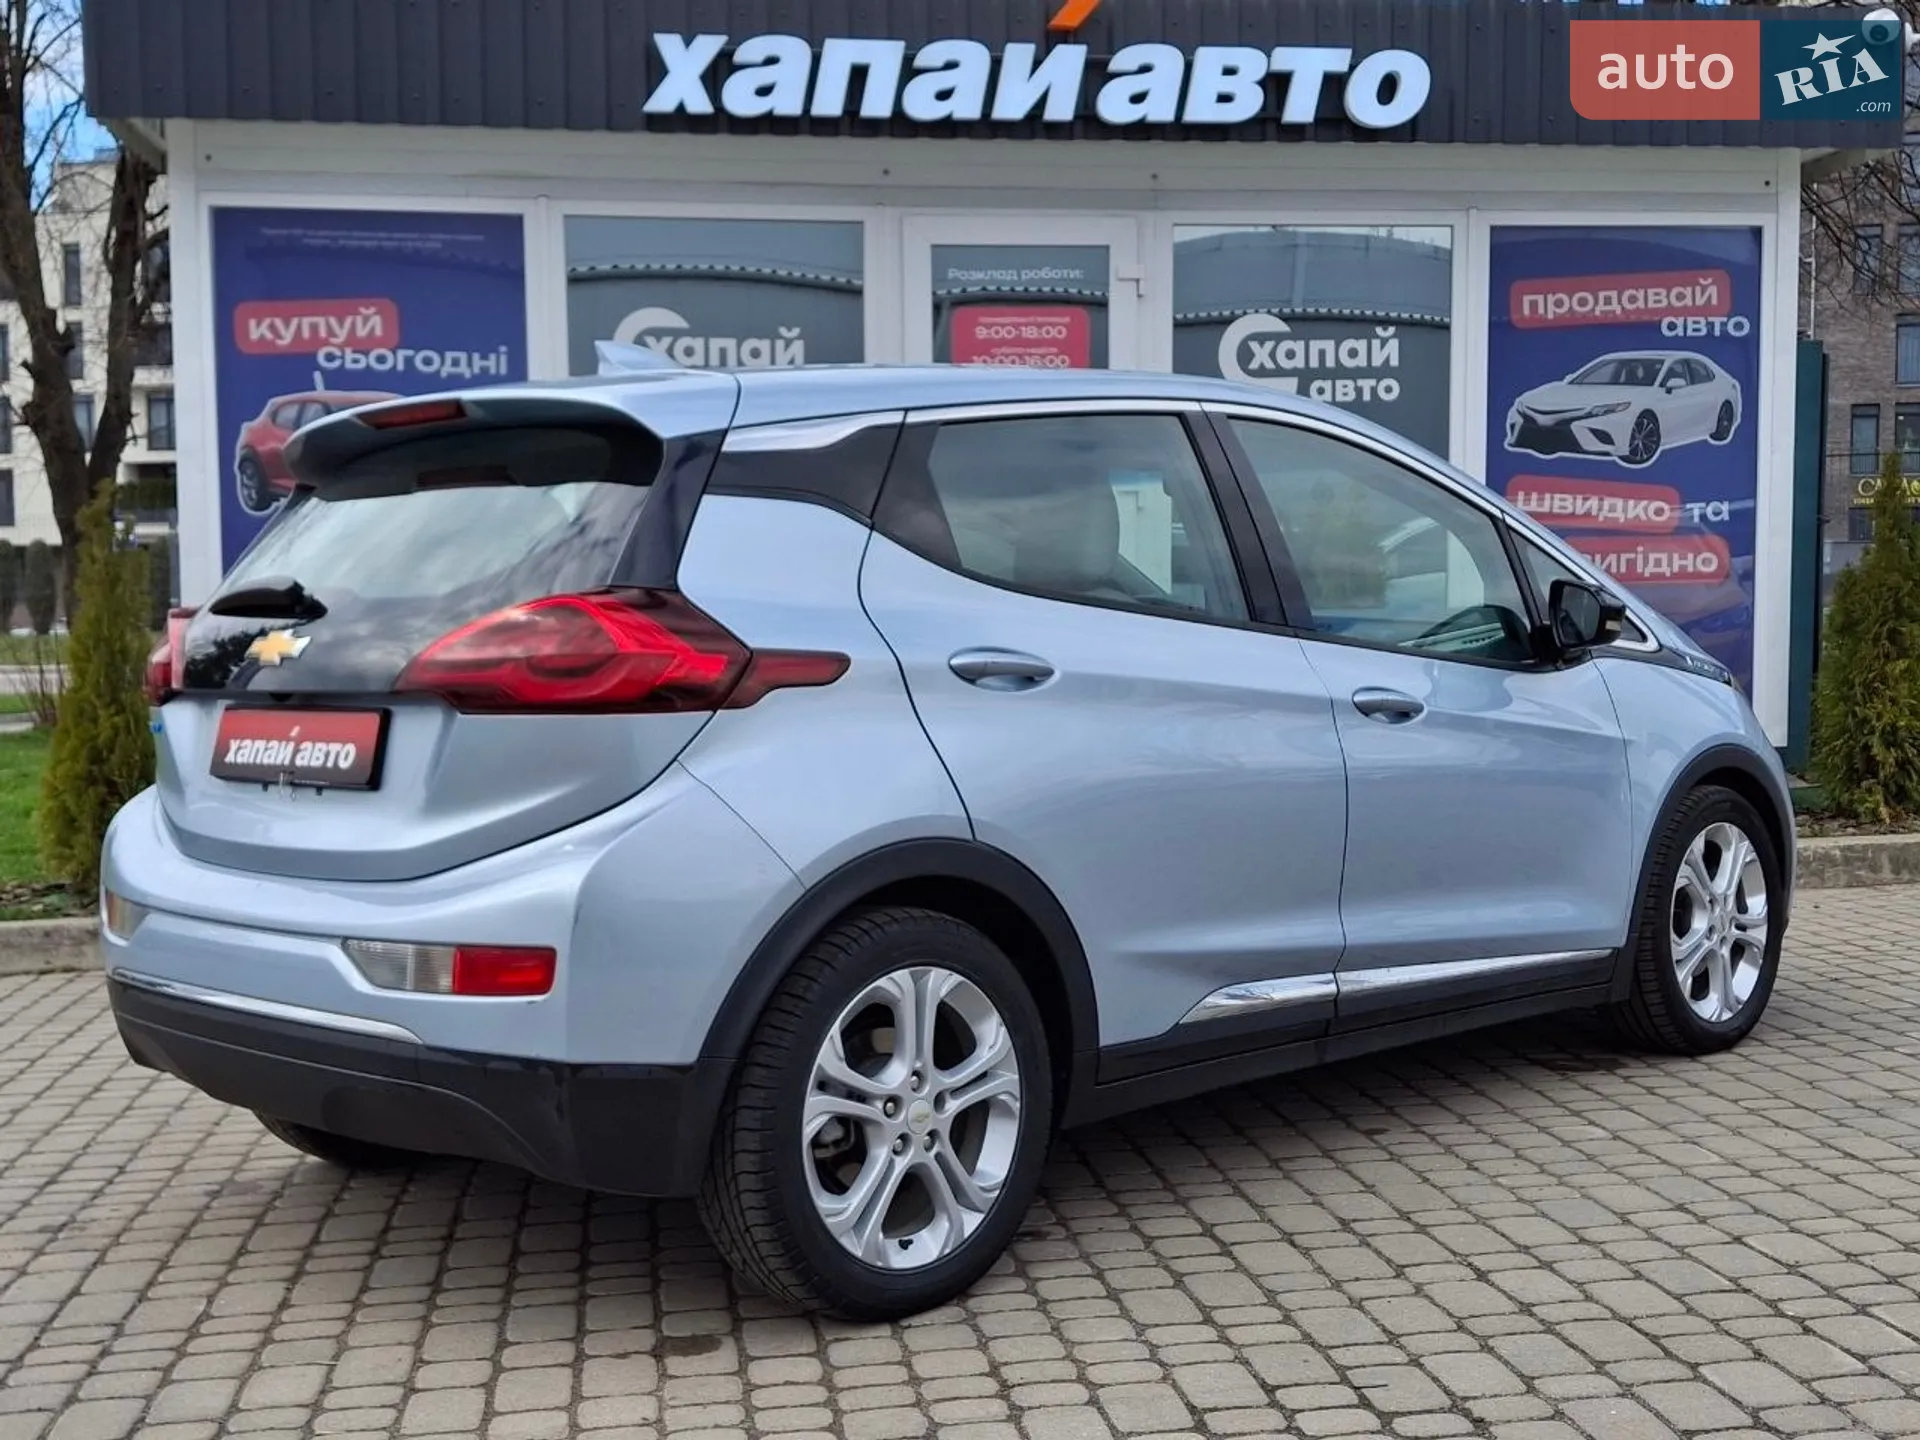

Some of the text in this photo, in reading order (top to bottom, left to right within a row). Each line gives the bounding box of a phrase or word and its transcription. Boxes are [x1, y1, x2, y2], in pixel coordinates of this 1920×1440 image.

[1096, 43, 1431, 129] авто
[948, 266, 1084, 281] Розклад роботи:
[1522, 278, 1718, 319] продавай
[249, 307, 383, 346] купуй
[974, 325, 1068, 339] 9:00-18:00
[1660, 316, 1750, 337] авто
[316, 346, 508, 379] сьогодні
[1247, 326, 1399, 369] хапай
[1309, 377, 1400, 401] авто
[1516, 491, 1729, 523] швидко та
[224, 726, 357, 770] хапай авто
